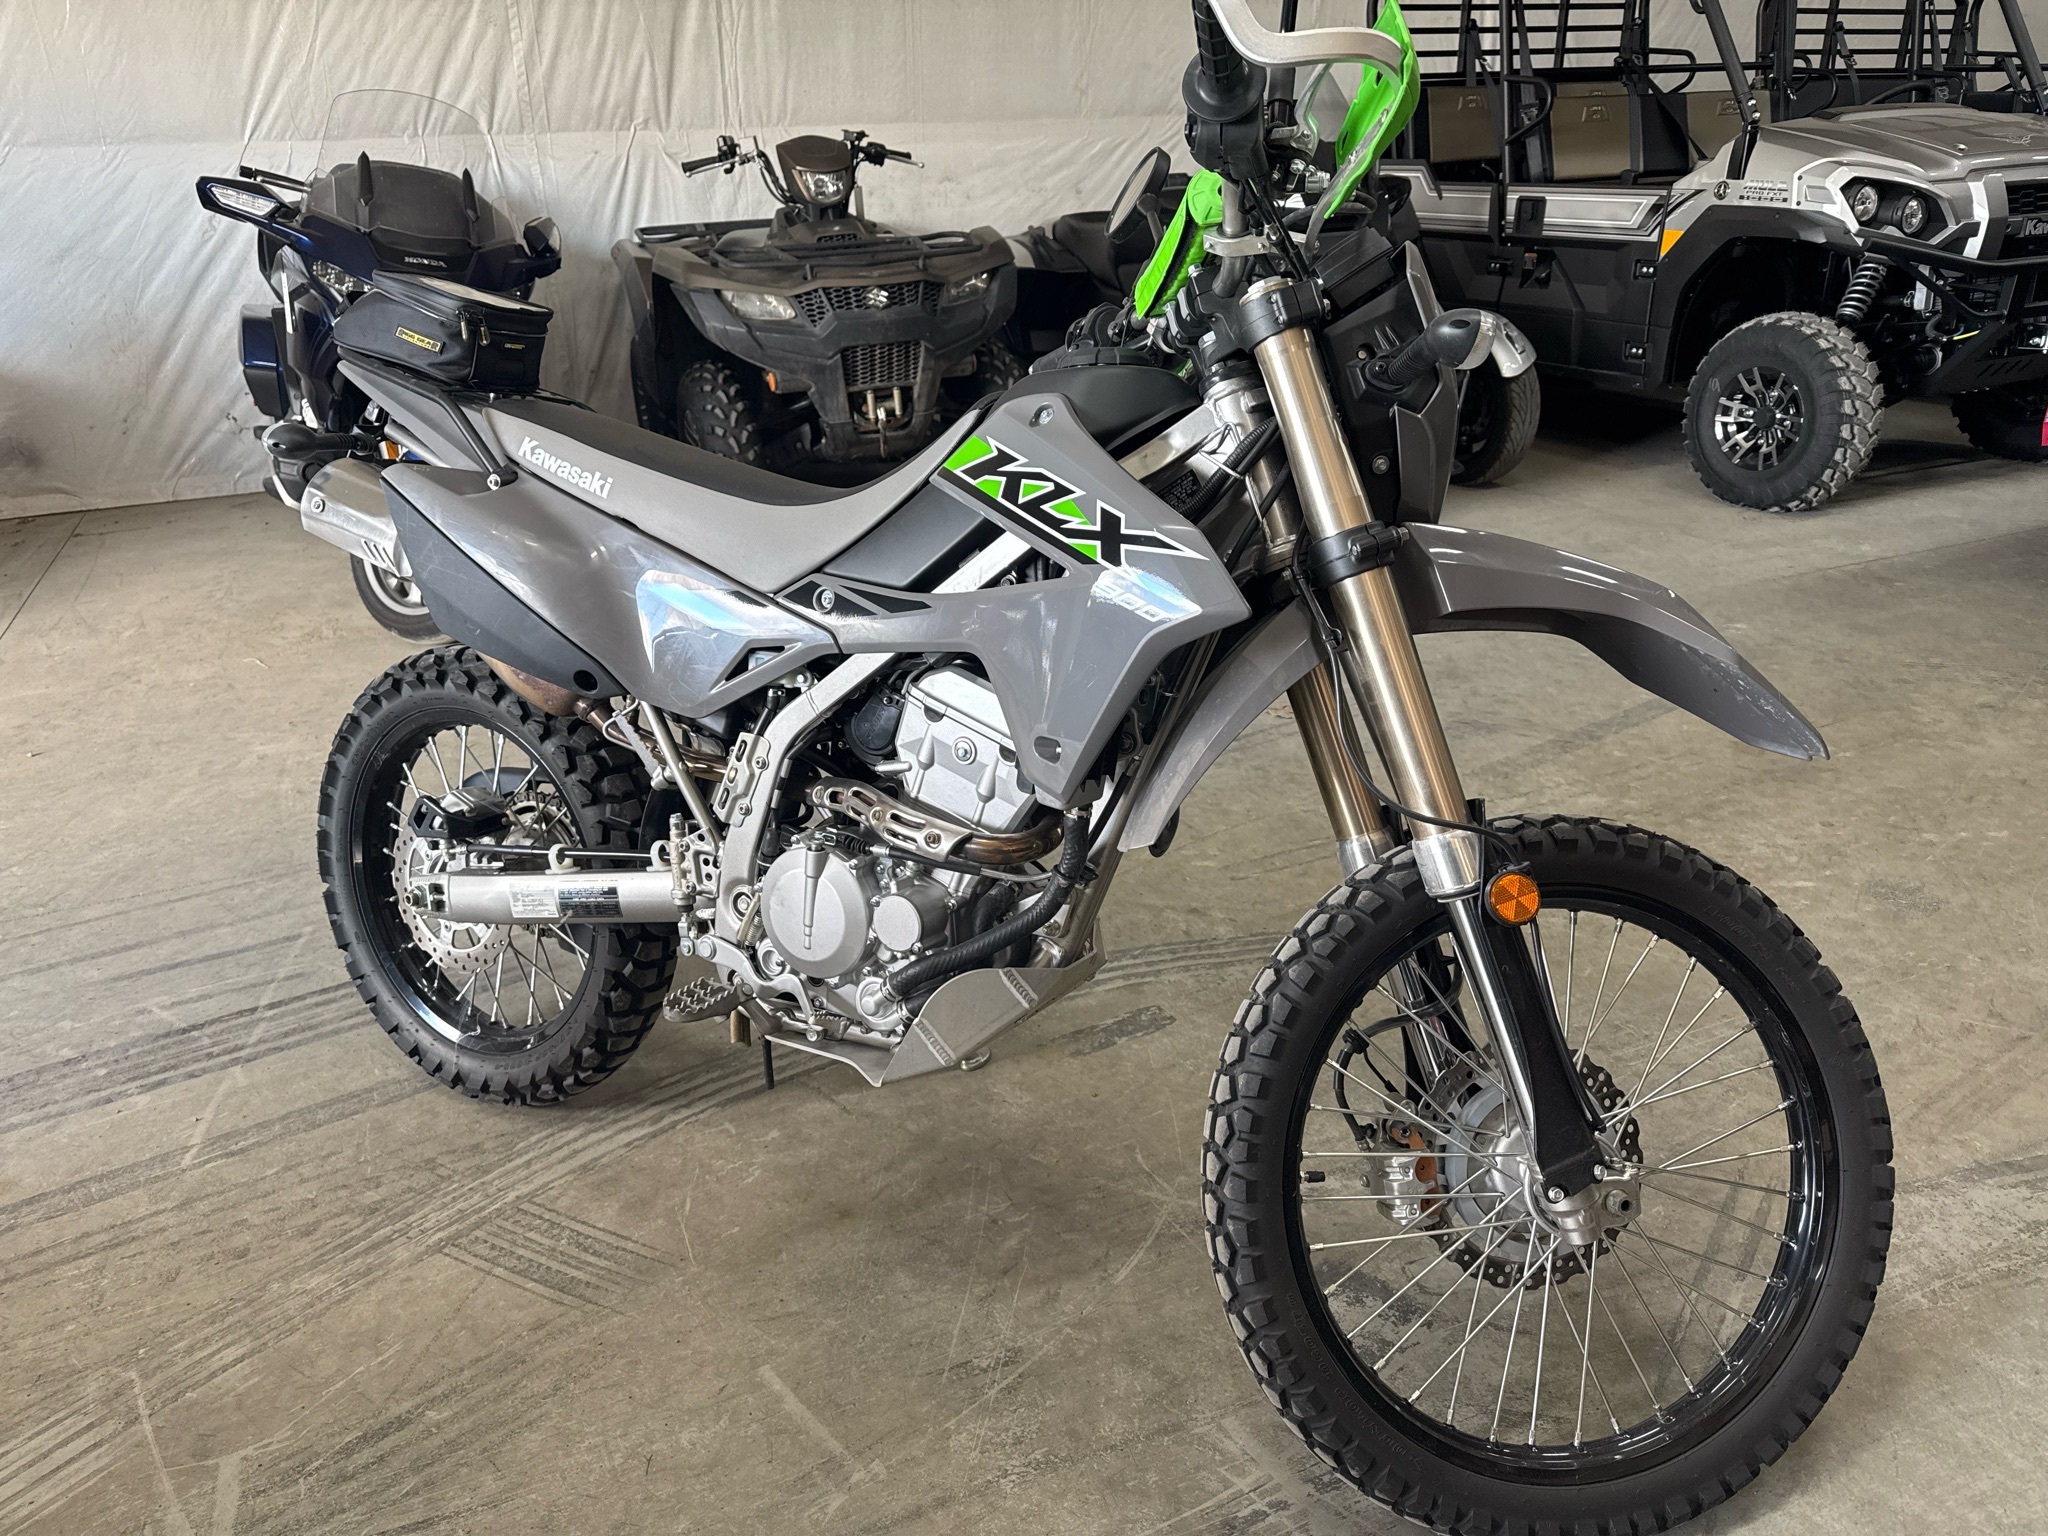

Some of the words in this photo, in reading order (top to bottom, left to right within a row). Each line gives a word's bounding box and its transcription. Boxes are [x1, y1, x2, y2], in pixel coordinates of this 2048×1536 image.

[404, 256, 448, 268] HONDA
[518, 436, 614, 499] Kawasaki
[952, 435, 1210, 571] KLX
[1334, 1387, 1408, 1458] DUNLOP
